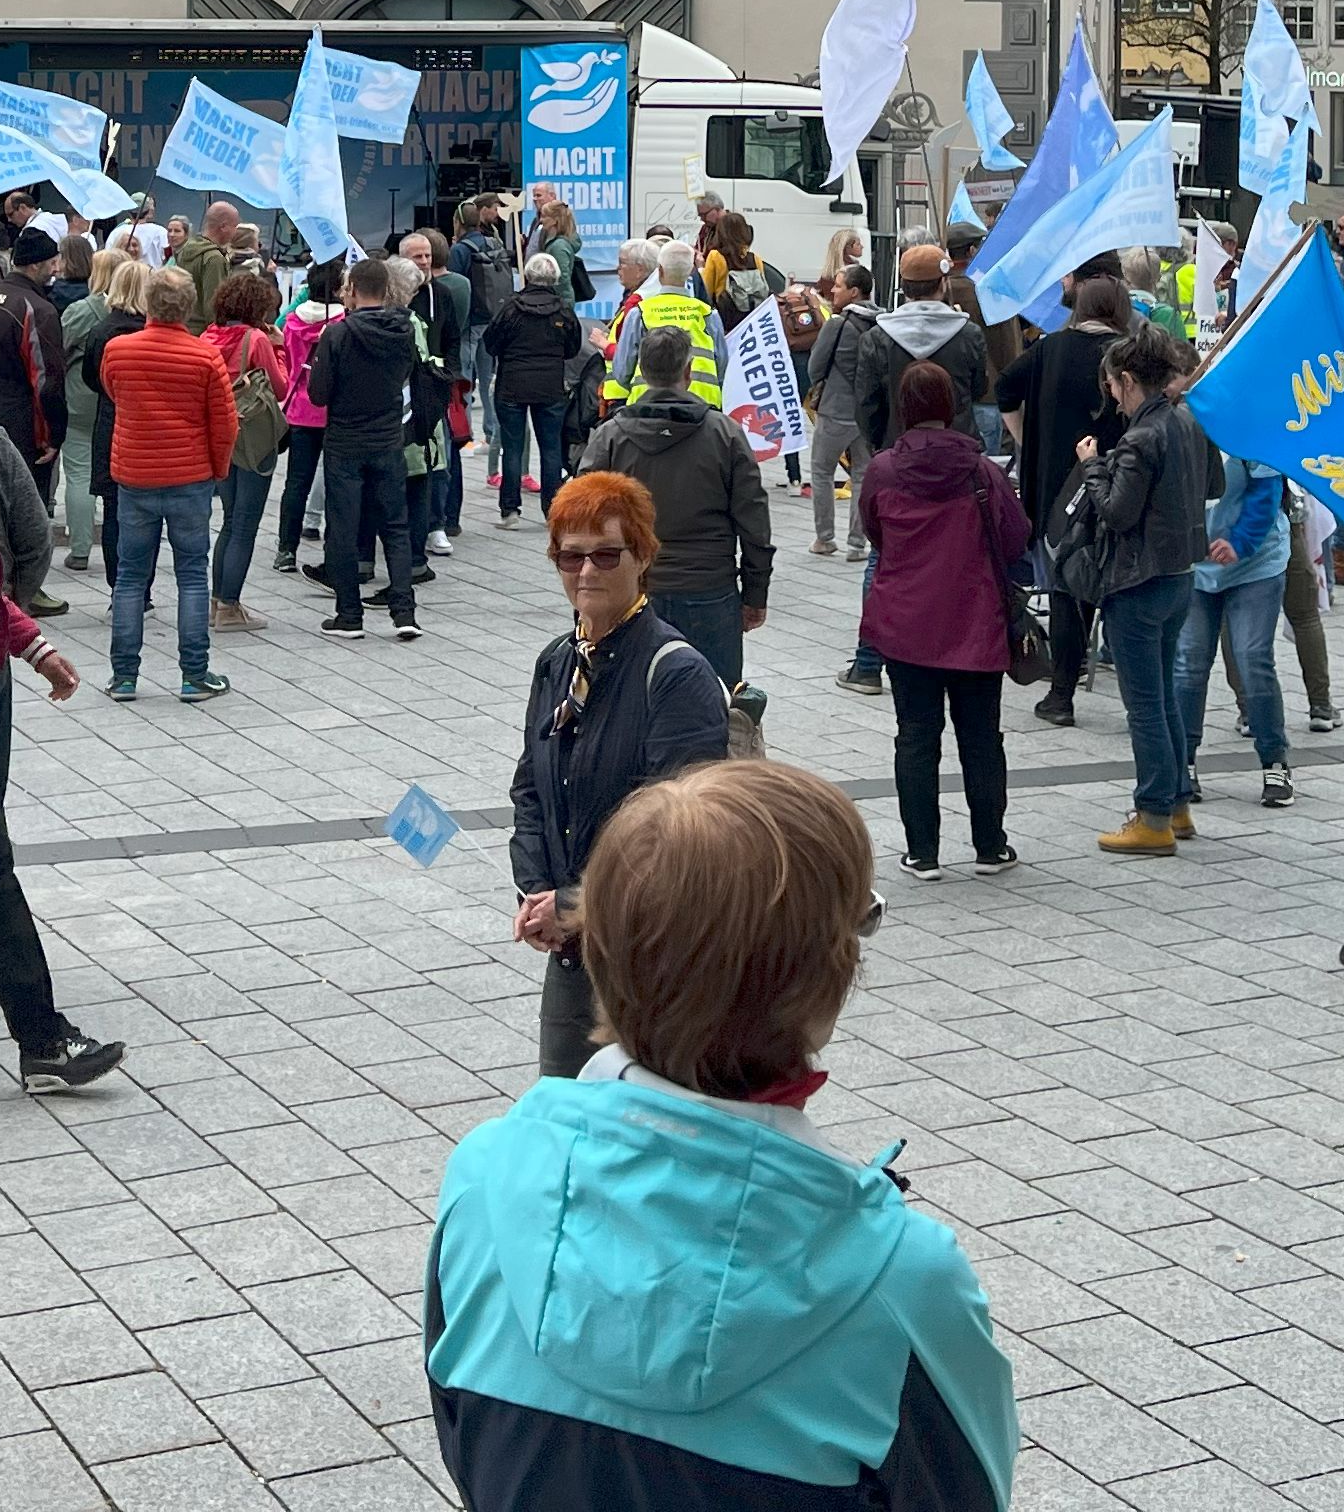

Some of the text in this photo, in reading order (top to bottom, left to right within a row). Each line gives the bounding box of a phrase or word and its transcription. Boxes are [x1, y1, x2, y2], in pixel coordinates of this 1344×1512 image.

[414, 69, 522, 113] MACH
[183, 120, 252, 175] FRIEDEN
[194, 95, 260, 149] MACHT
[534, 146, 616, 177] MACHT
[758, 311, 803, 437] WIR FORDERN
